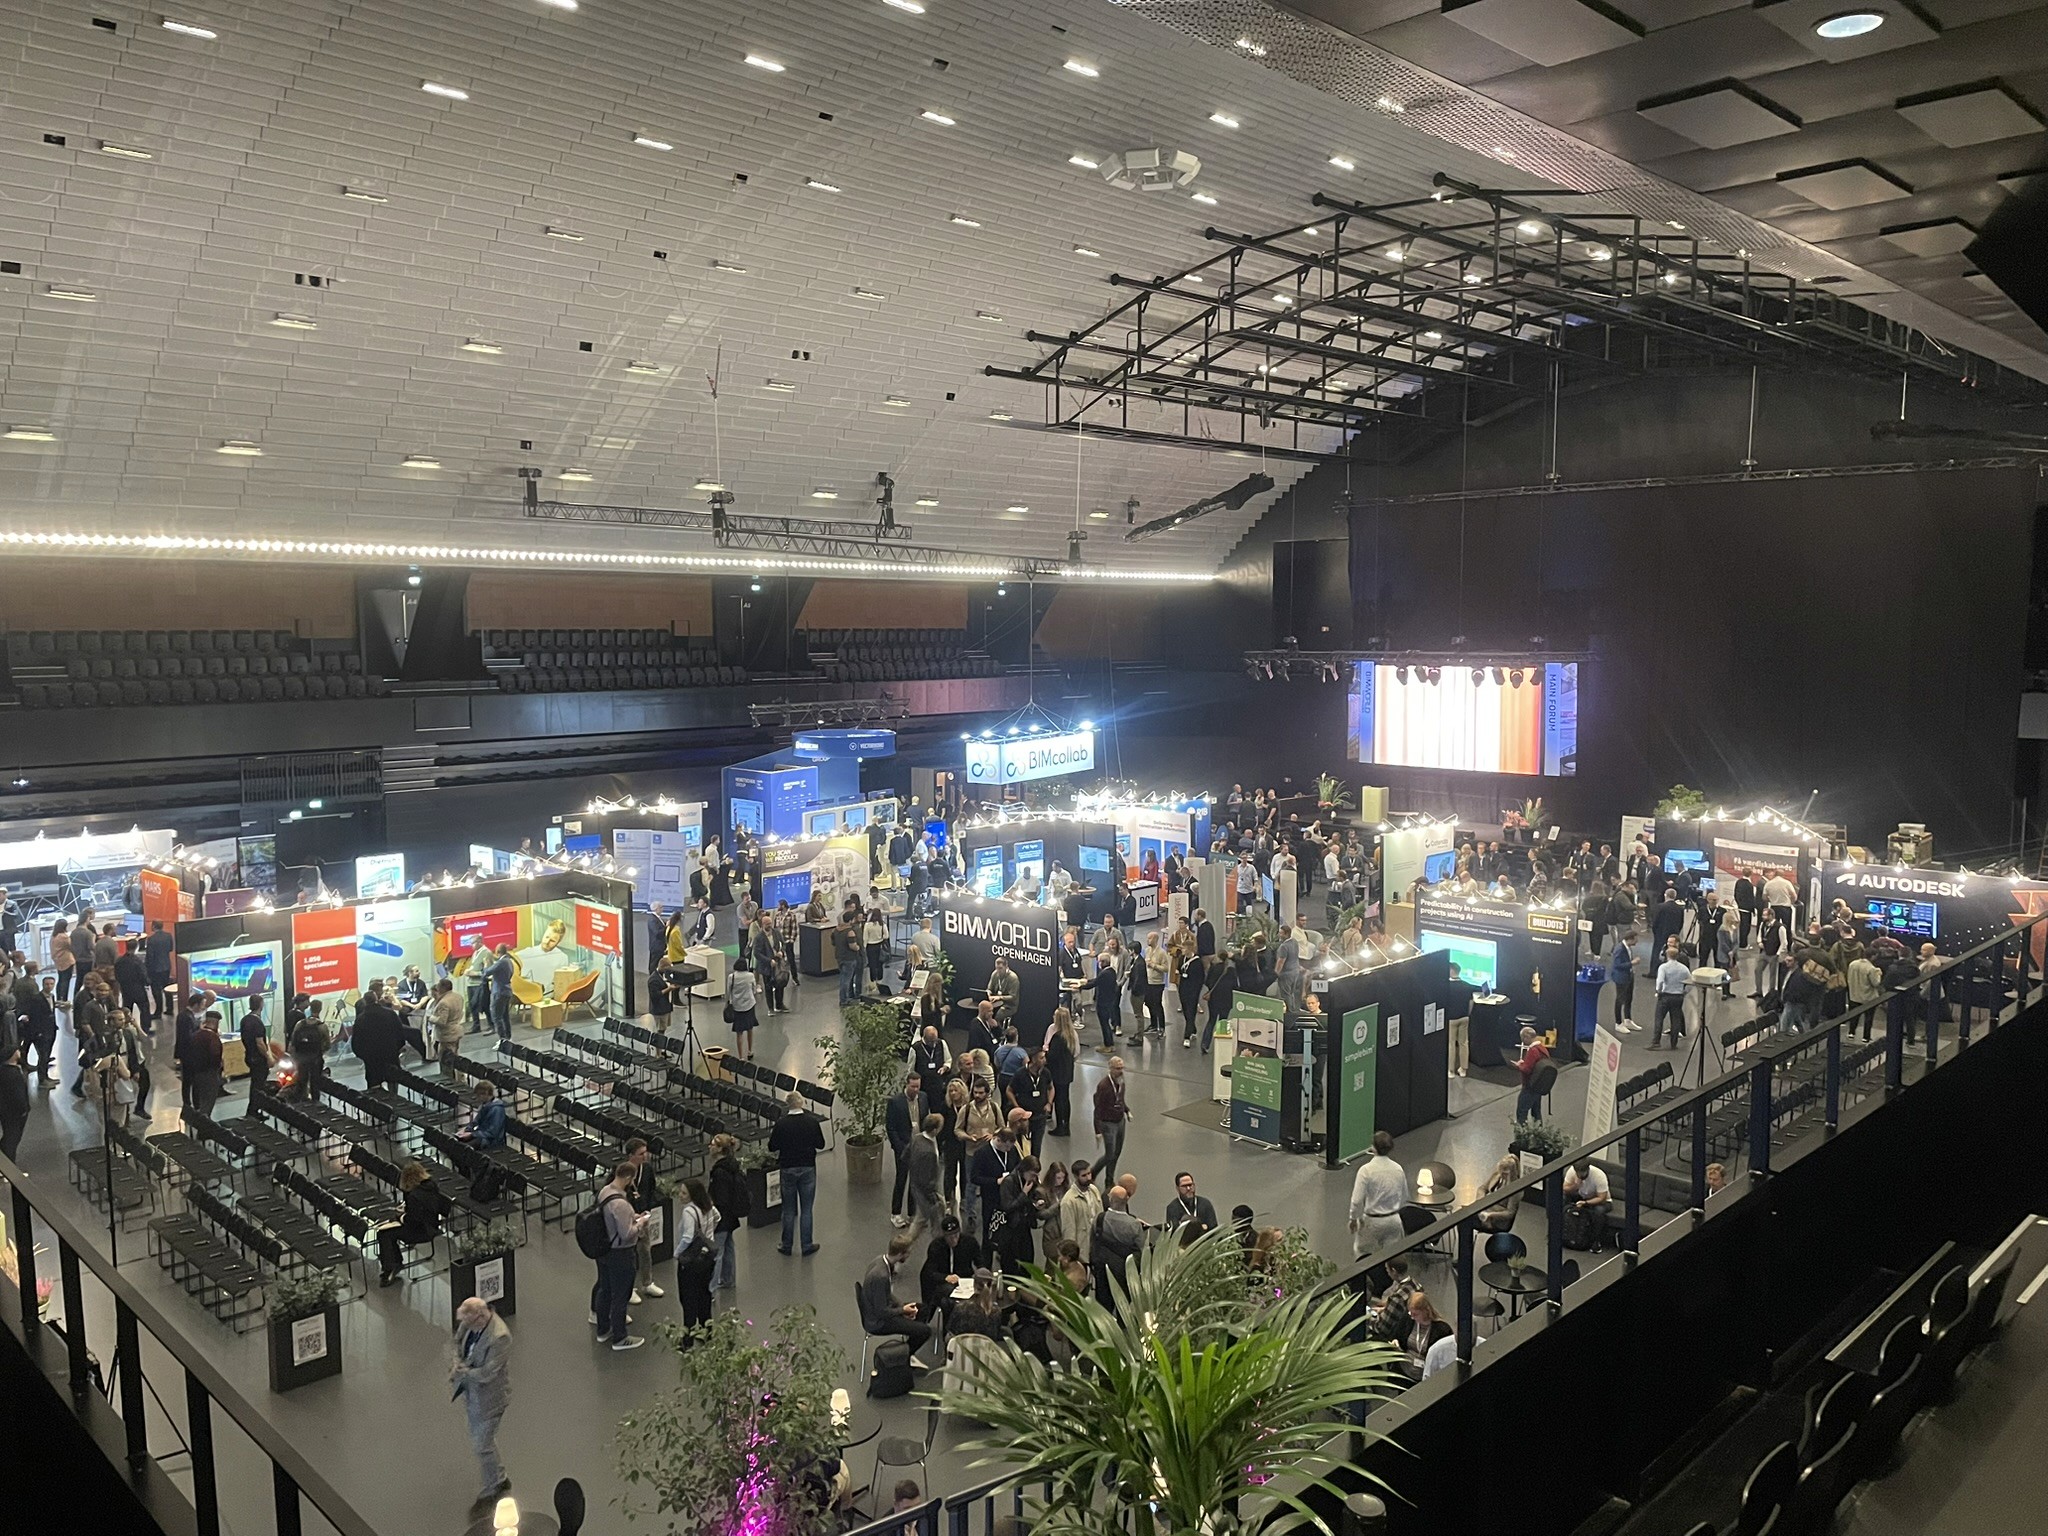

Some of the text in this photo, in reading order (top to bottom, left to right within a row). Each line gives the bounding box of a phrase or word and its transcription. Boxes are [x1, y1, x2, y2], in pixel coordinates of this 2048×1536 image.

[1548, 674, 1557, 732] MAIN FORUM
[1029, 745, 1088, 769] BIMcollab
[144, 880, 162, 895] MARS
[1859, 874, 1965, 898] AUTODESK
[1139, 894, 1155, 908] DCT
[1420, 898, 1463, 912] Predictability
[1471, 906, 1514, 918] construction
[1420, 908, 1446, 917] projects
[1447, 911, 1465, 920] using
[1532, 918, 1564, 930] BUILDOTS
[945, 910, 1052, 953] BIMWORLD
[991, 944, 1052, 966] COPENHAGEN
